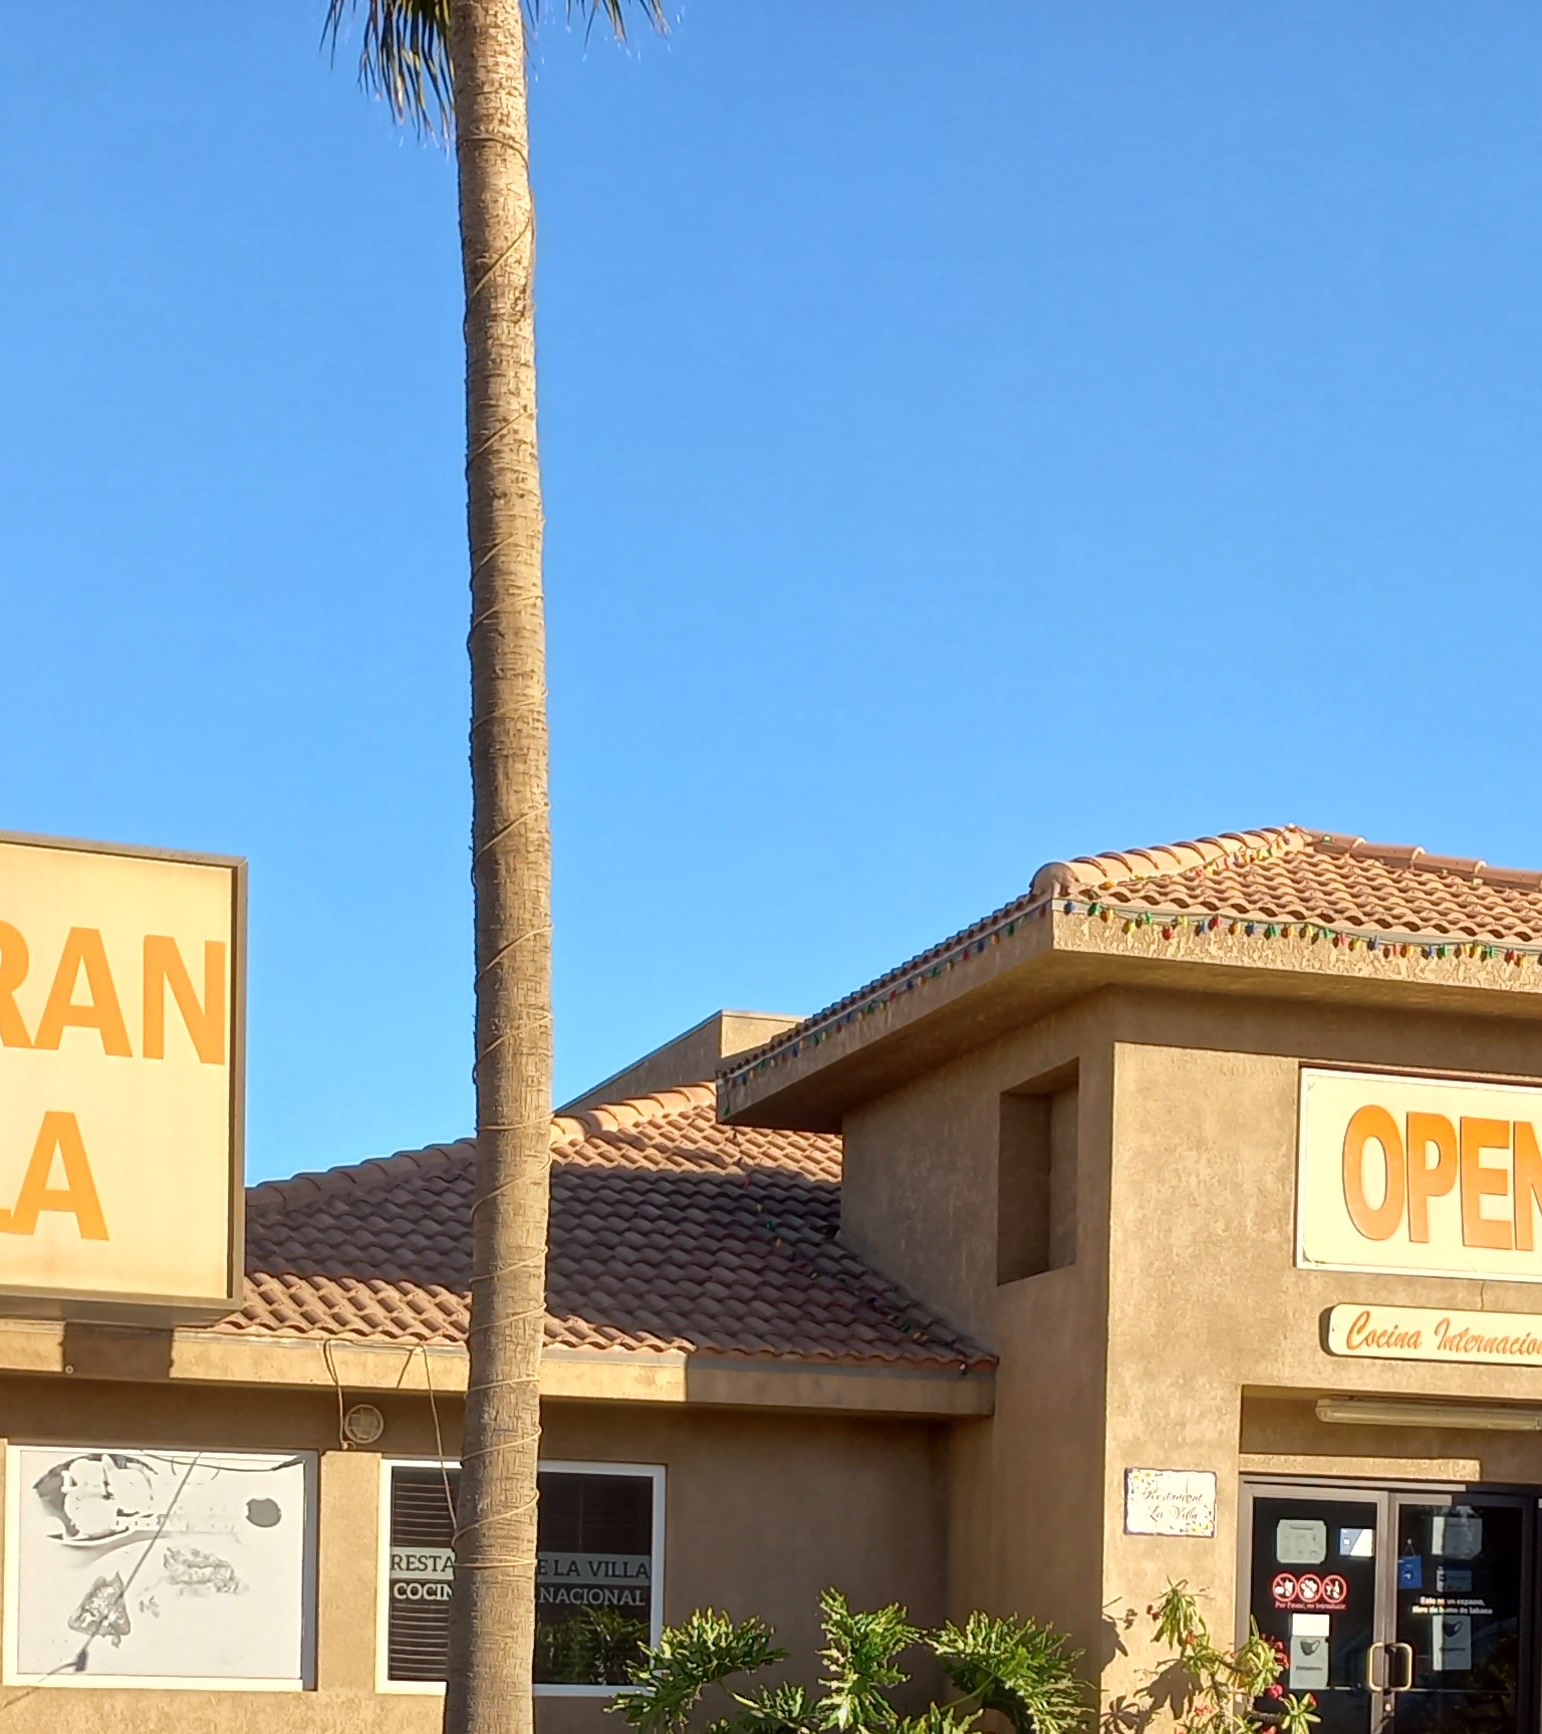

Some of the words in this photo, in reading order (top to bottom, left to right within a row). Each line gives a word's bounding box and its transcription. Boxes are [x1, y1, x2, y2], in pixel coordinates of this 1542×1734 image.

[1345, 1310, 1423, 1351] Cocina
[553, 1559, 582, 1577] LA
[587, 1560, 651, 1580] VILLA
[394, 1581, 455, 1602] COCIN
[537, 1586, 646, 1607] NACIONAL
